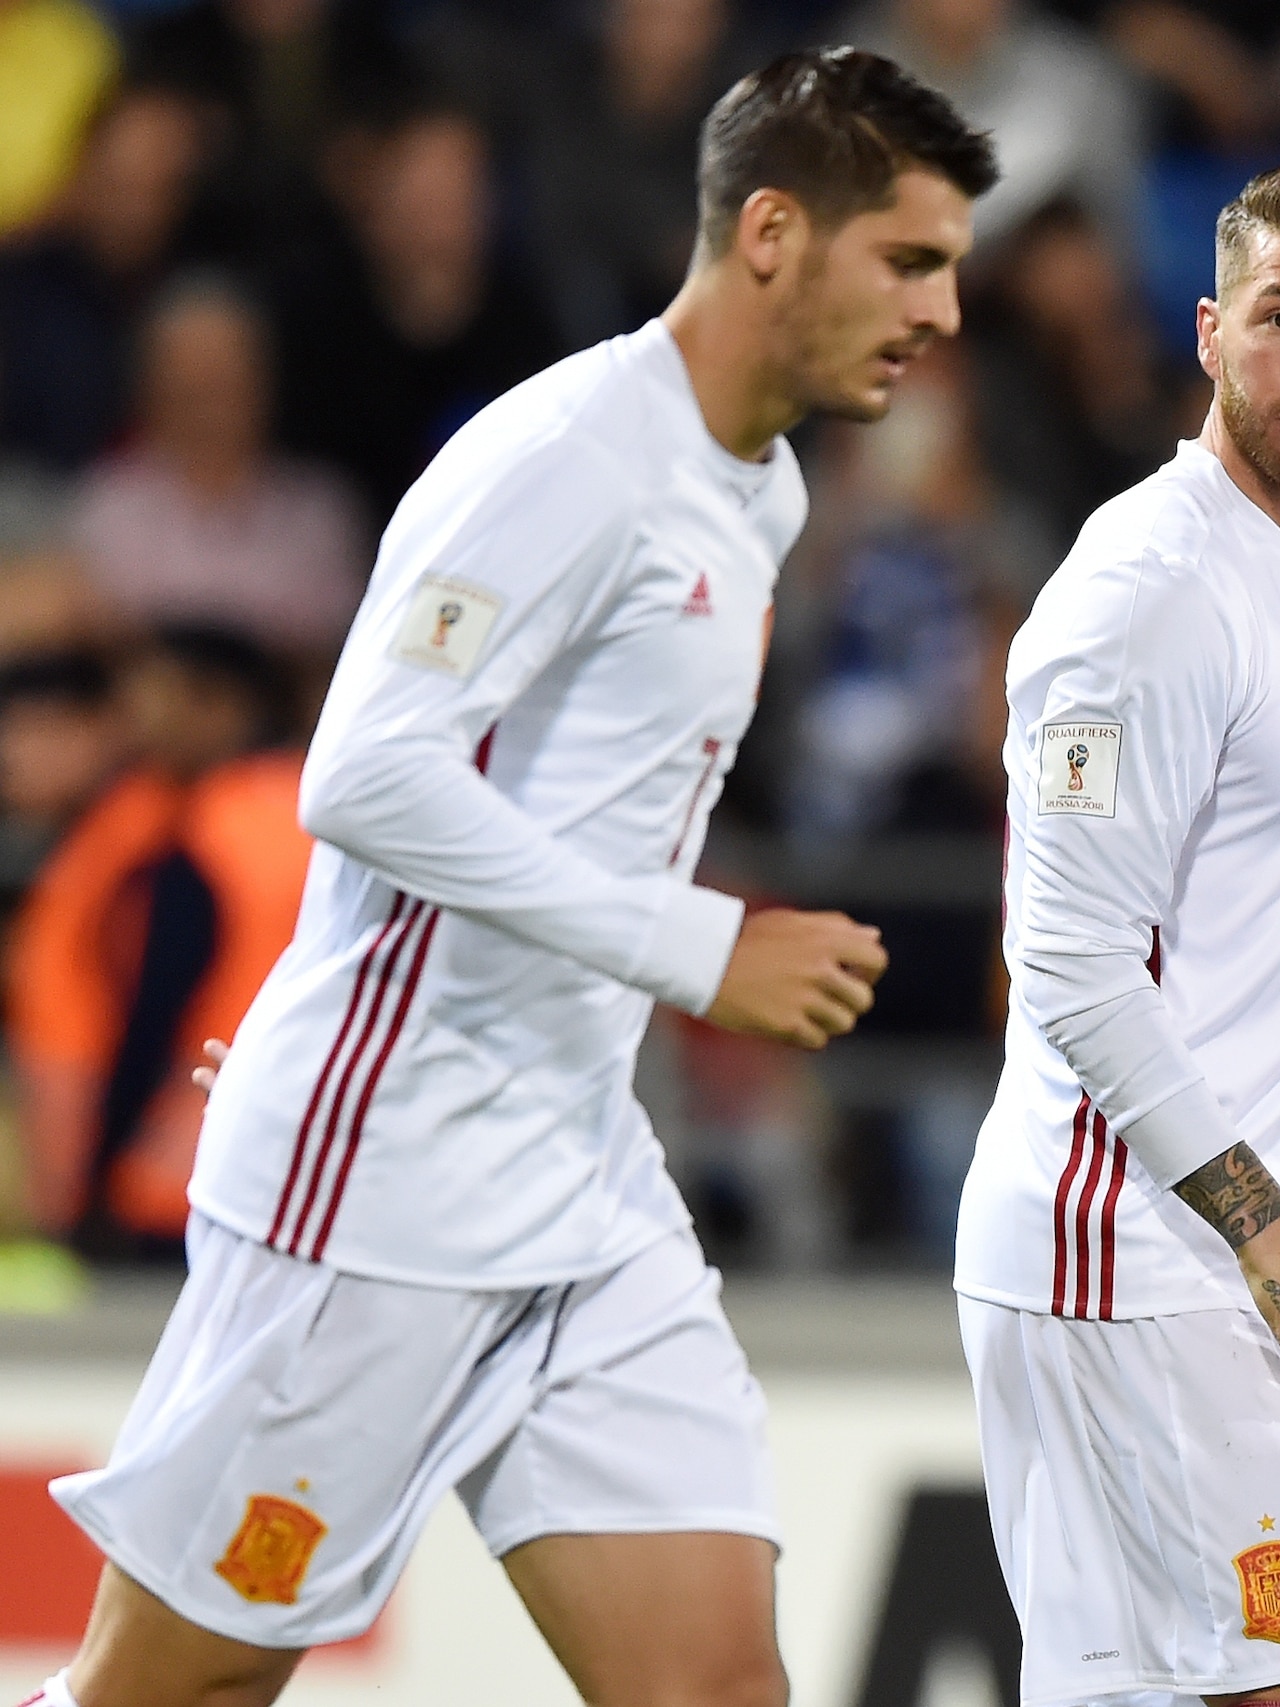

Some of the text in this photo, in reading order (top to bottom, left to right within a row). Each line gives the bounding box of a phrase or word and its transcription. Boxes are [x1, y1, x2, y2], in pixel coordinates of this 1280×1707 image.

[1047, 727, 1117, 741] QUALIFIERS
[1045, 800, 1080, 809] RUSSIA
[1081, 1650, 1120, 1662] adizero
